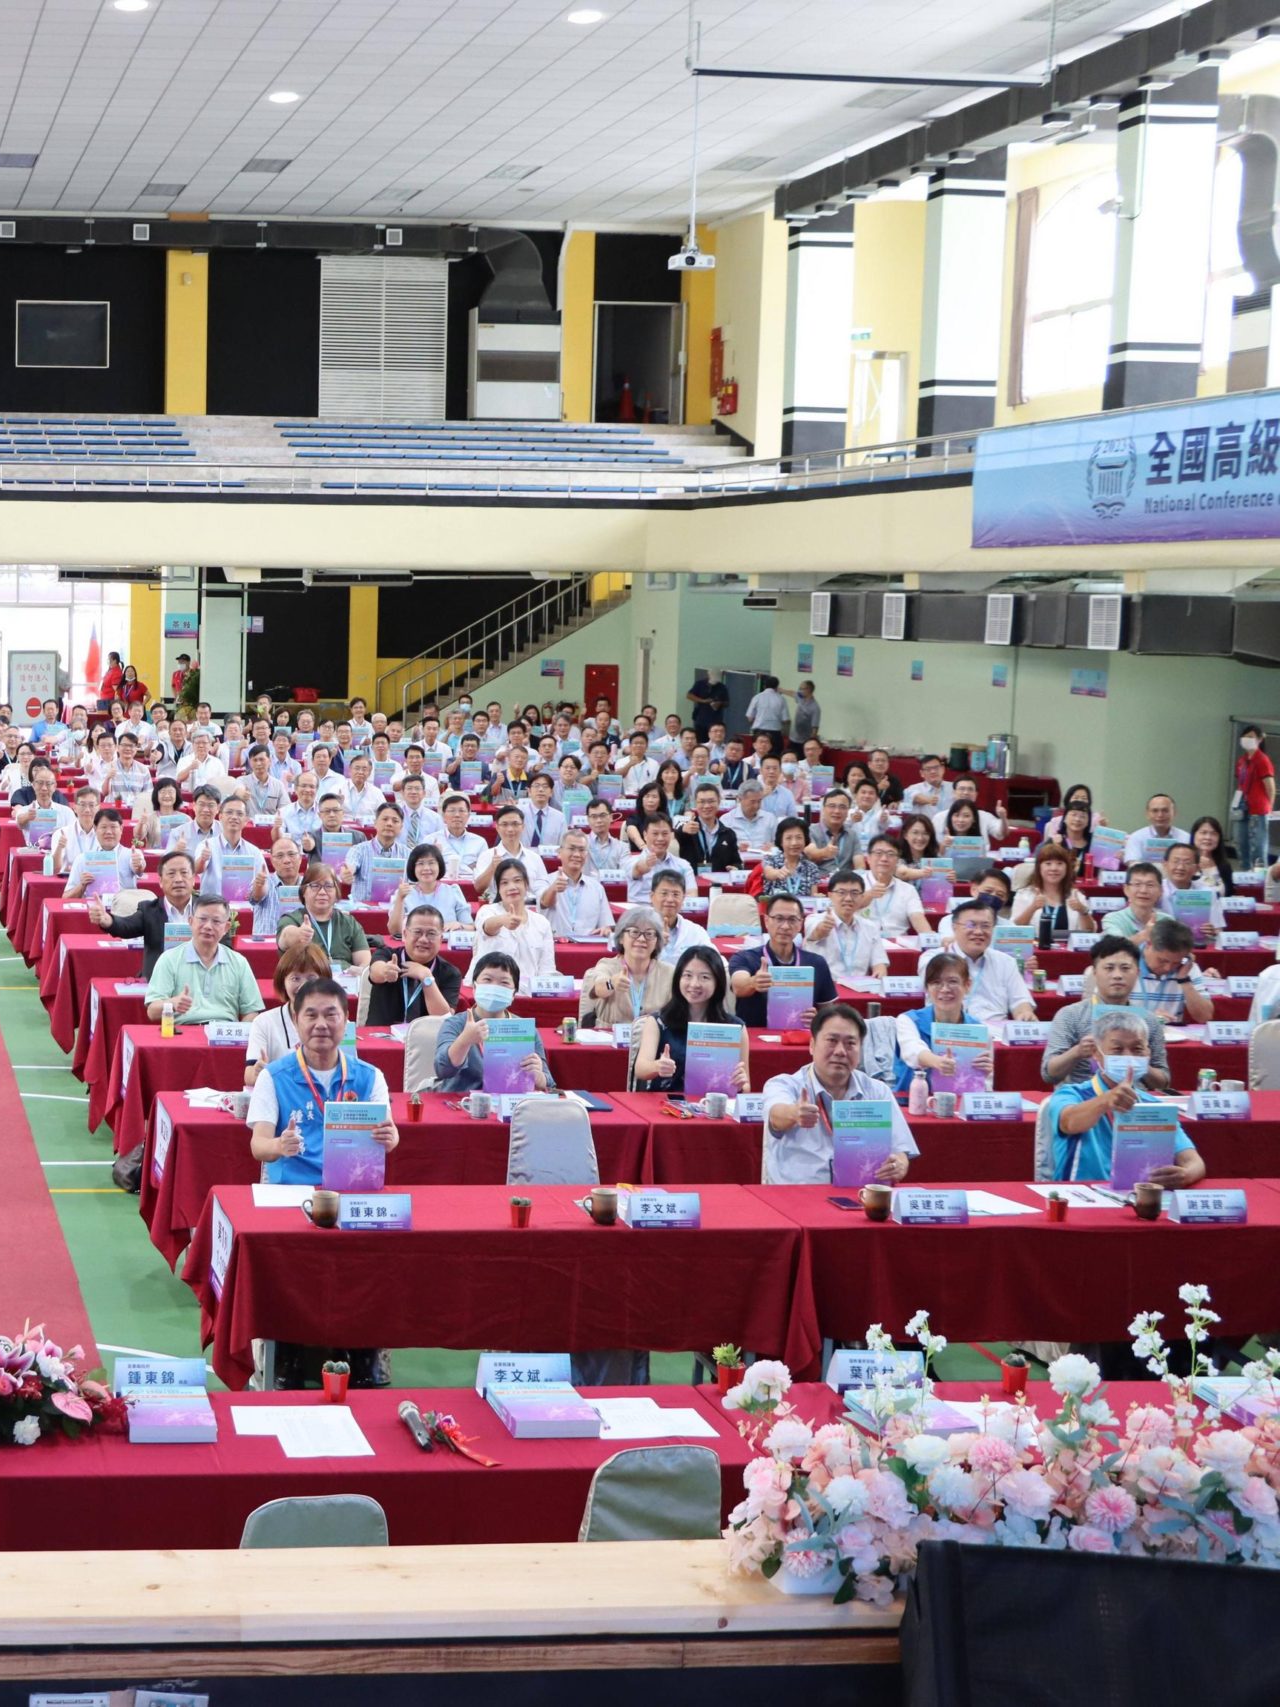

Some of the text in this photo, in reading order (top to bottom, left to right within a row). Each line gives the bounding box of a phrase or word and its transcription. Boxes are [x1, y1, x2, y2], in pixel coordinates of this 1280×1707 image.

[1146, 418, 1280, 486] 全國高級
[1144, 490, 1273, 514] National Conference
[350, 1207, 387, 1218] 鍾東錦
[641, 1203, 676, 1214] 李文斌
[128, 1371, 174, 1385] 鍾東錦
[494, 1369, 541, 1383] 李文斌
